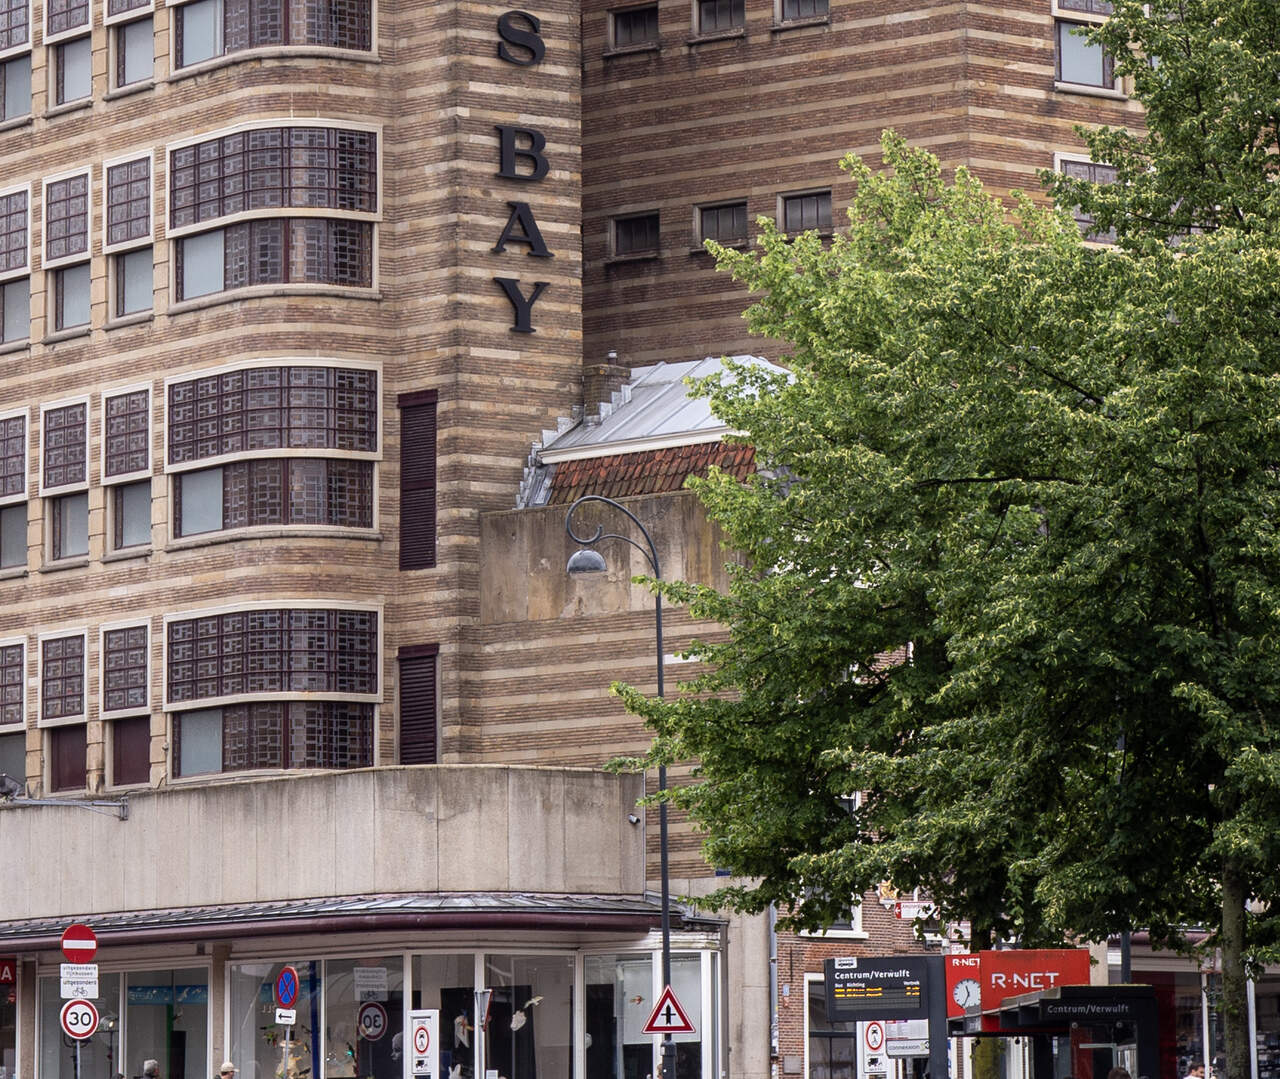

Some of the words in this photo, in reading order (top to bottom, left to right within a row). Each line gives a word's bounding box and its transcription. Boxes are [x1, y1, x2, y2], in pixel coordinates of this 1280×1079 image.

[490, 124, 556, 334] BAY
[834, 969, 911, 980] Centrum/Verwulft
[1047, 1004, 1129, 1015] Centrum/Verwulft
[68, 1011, 92, 1027] 30
